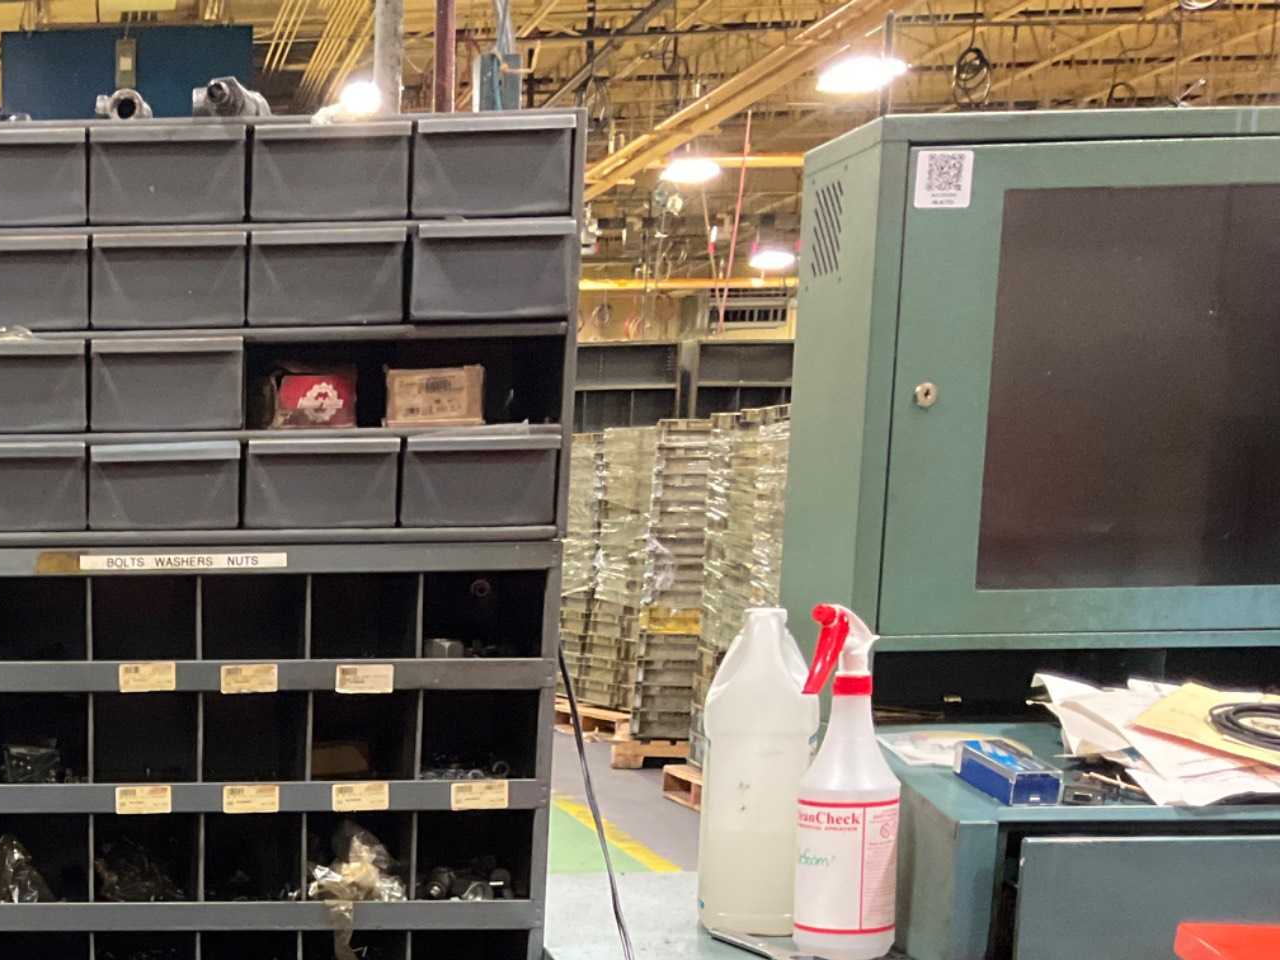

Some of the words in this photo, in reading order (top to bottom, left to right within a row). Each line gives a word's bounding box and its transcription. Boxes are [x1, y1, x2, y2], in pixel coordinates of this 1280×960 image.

[106, 557, 145, 569] BOLTS
[154, 556, 214, 568] WASHERS
[226, 555, 259, 567] NUTS
